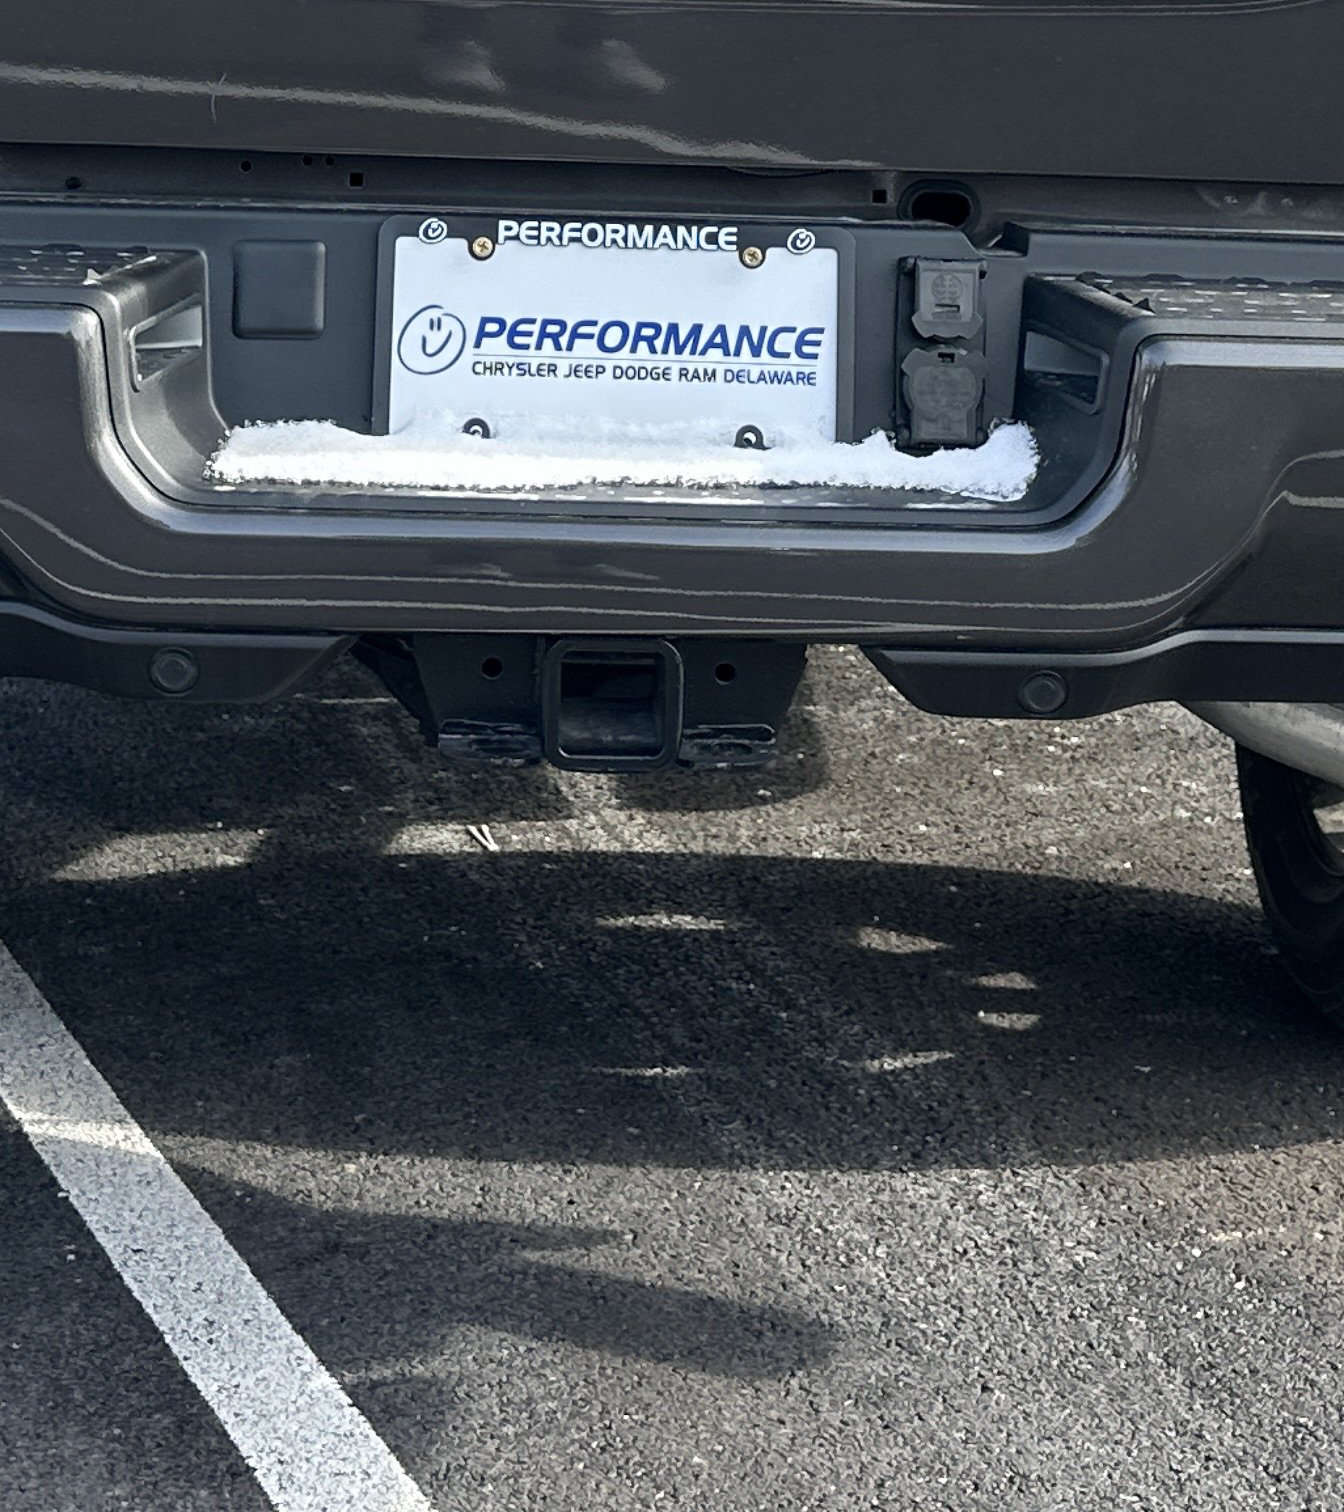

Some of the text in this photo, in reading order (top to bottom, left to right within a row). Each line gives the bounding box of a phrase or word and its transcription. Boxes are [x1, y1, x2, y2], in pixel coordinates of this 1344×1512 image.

[497, 219, 739, 251] PERFORMANCE
[472, 316, 825, 360] PERFORMANCE
[471, 360, 817, 387] CHRYSLER JEEP DODGE RAM DELAWARE
